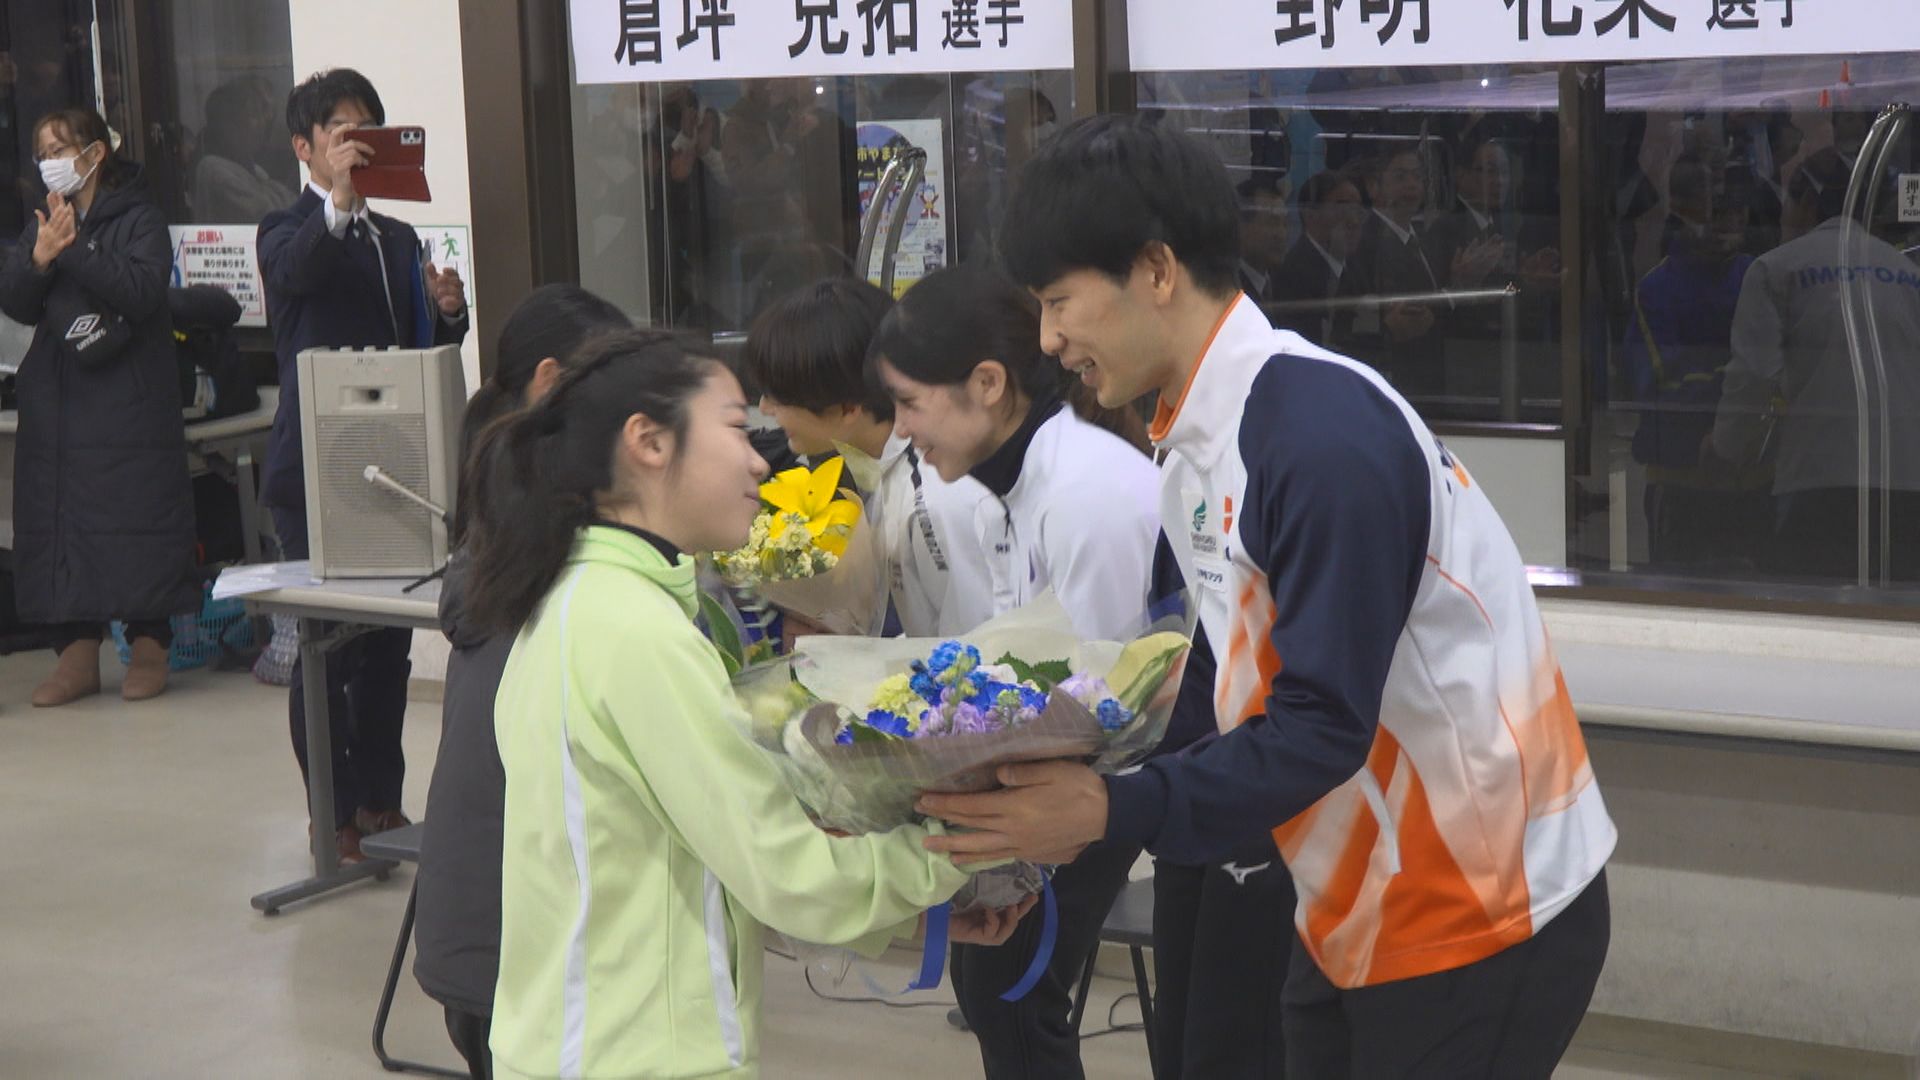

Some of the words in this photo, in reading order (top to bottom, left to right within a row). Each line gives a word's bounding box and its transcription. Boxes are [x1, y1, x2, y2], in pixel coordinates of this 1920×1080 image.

[1906, 179, 1919, 207] 押す
[197, 230, 224, 243] お願い
[76, 328, 107, 351] umbro
